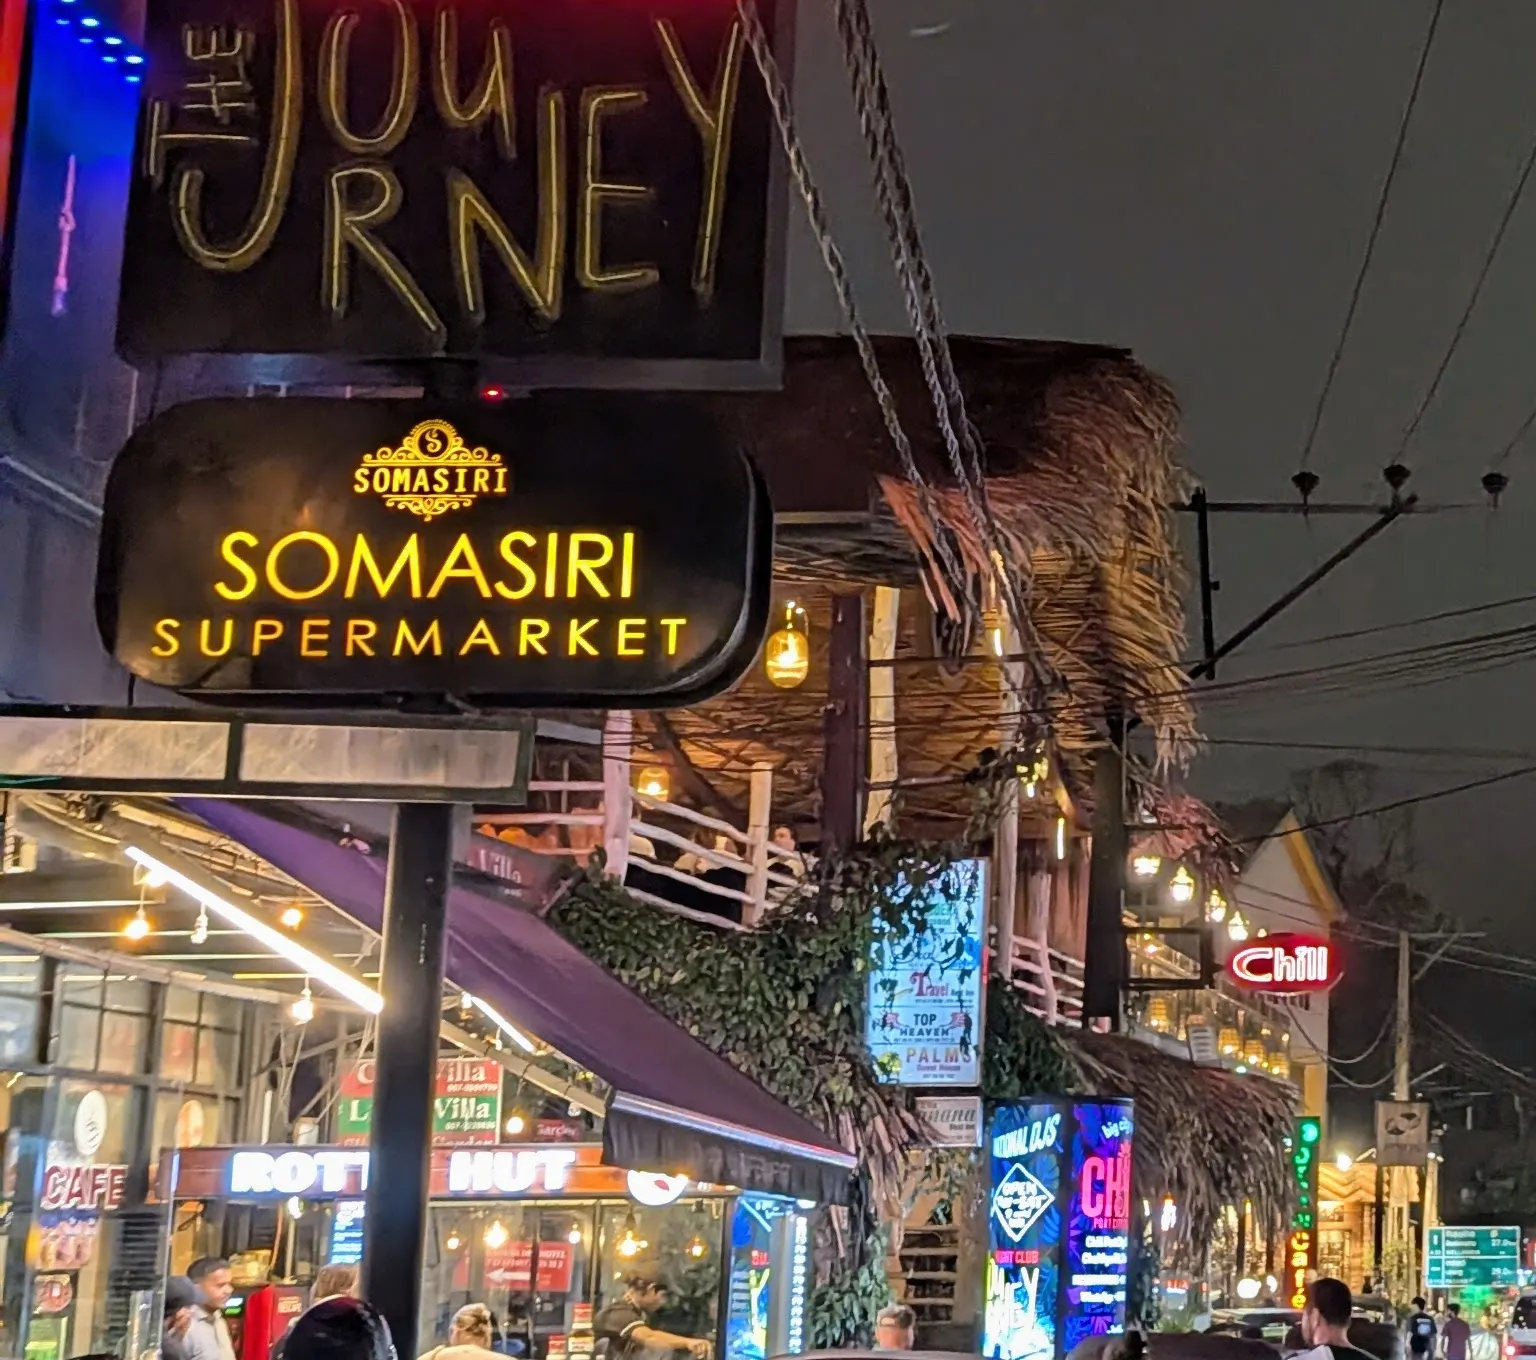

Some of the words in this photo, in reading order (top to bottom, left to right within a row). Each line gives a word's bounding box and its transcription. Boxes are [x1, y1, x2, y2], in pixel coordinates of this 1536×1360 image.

[141, 21, 255, 189] THE
[353, 467, 507, 494] SOMASIRI
[214, 530, 636, 601] SOMASIRI
[151, 617, 687, 658] SUPERMARKET
[1232, 945, 1328, 982] Chill
[909, 972, 949, 997] Travel
[900, 1027, 950, 1037] HEAVEN
[913, 1013, 938, 1026] TOP
[905, 1046, 972, 1063] PALMS
[449, 1150, 576, 1191] HUT
[41, 1164, 128, 1210] CAFE
[1015, 1250, 1040, 1264] CLUB
